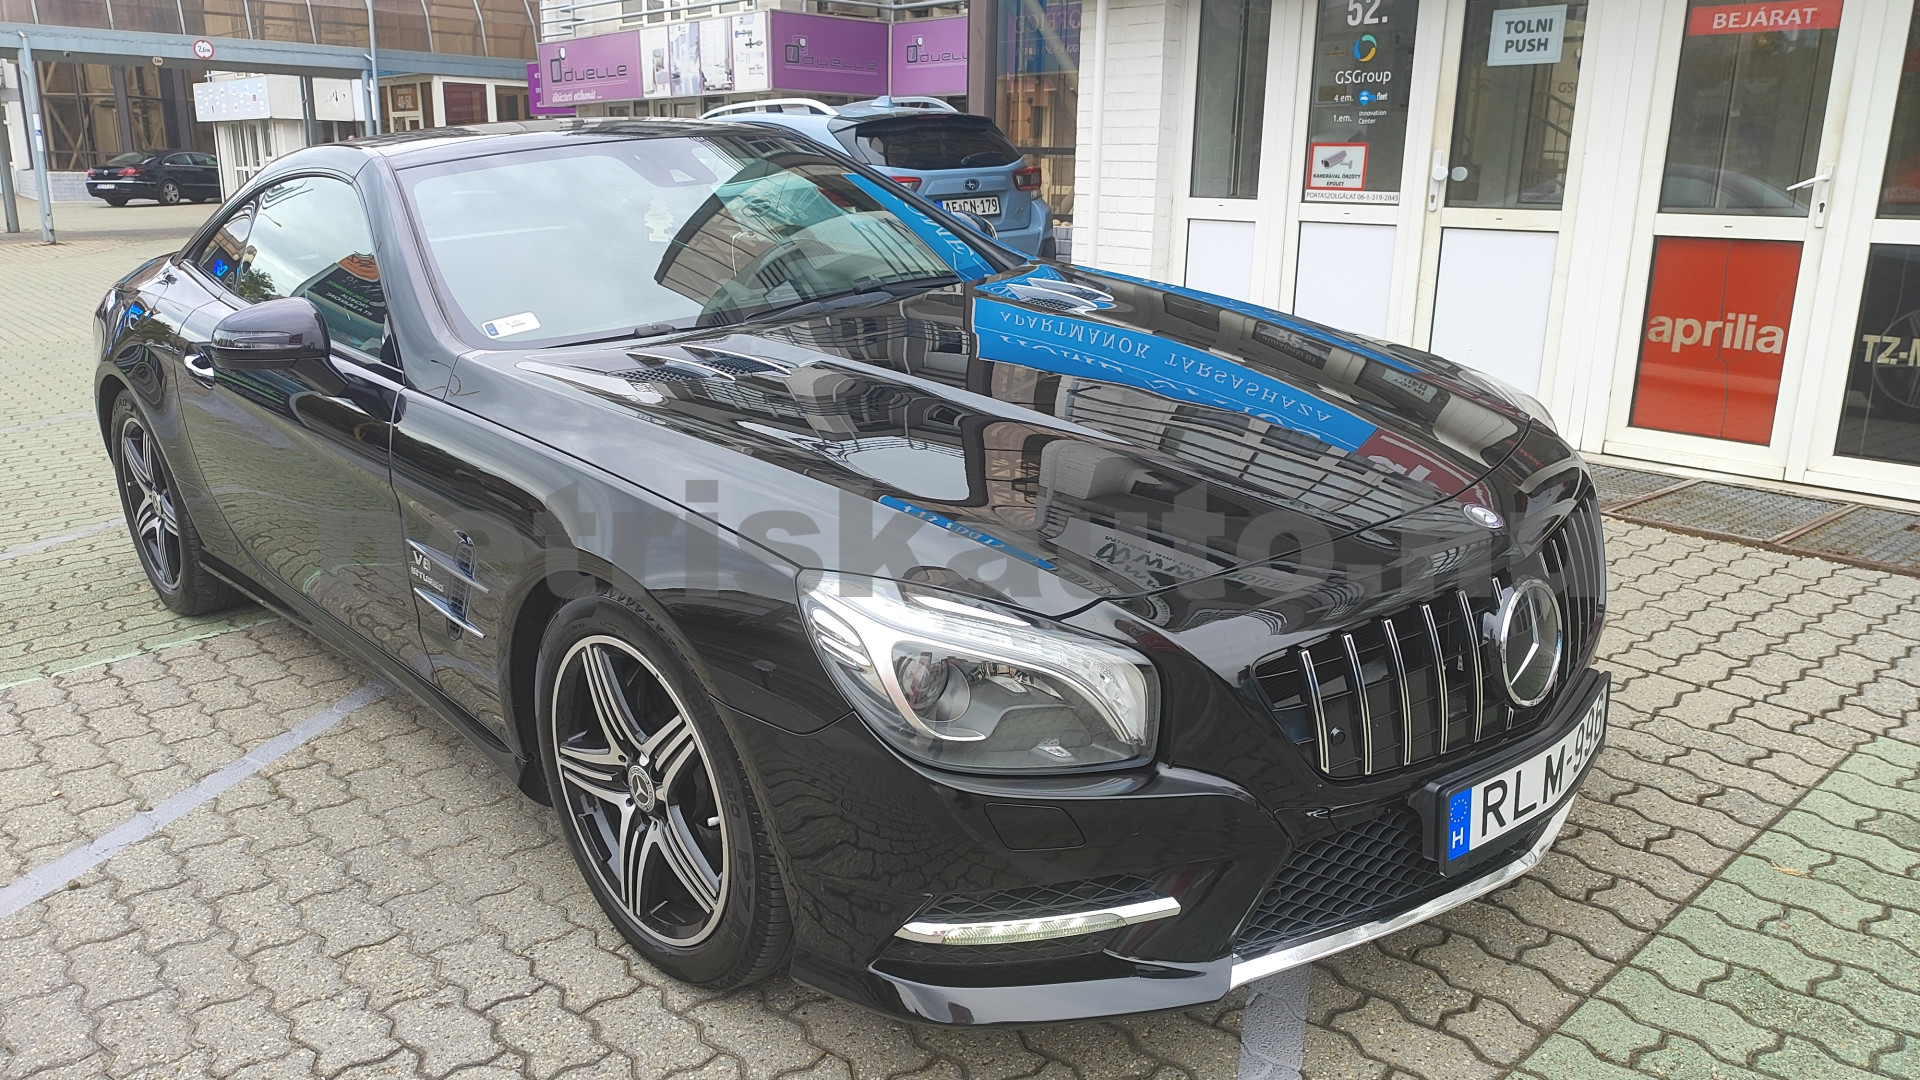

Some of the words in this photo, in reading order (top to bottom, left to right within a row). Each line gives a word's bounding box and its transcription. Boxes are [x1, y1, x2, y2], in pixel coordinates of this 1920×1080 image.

[1347, 0, 1388, 26] 52.
[1712, 6, 1818, 30] BEJÁRAT
[1504, 18, 1554, 35] TOLNI
[1504, 38, 1549, 53] PUSH
[1335, 70, 1392, 84] GSGroup
[1558, 81, 1577, 94] GS
[1333, 94, 1339, 102] 4
[1647, 312, 1785, 355] aprilia
[413, 550, 431, 571] V8
[1482, 692, 1603, 837] RLM-996
[1452, 827, 1464, 849] H
